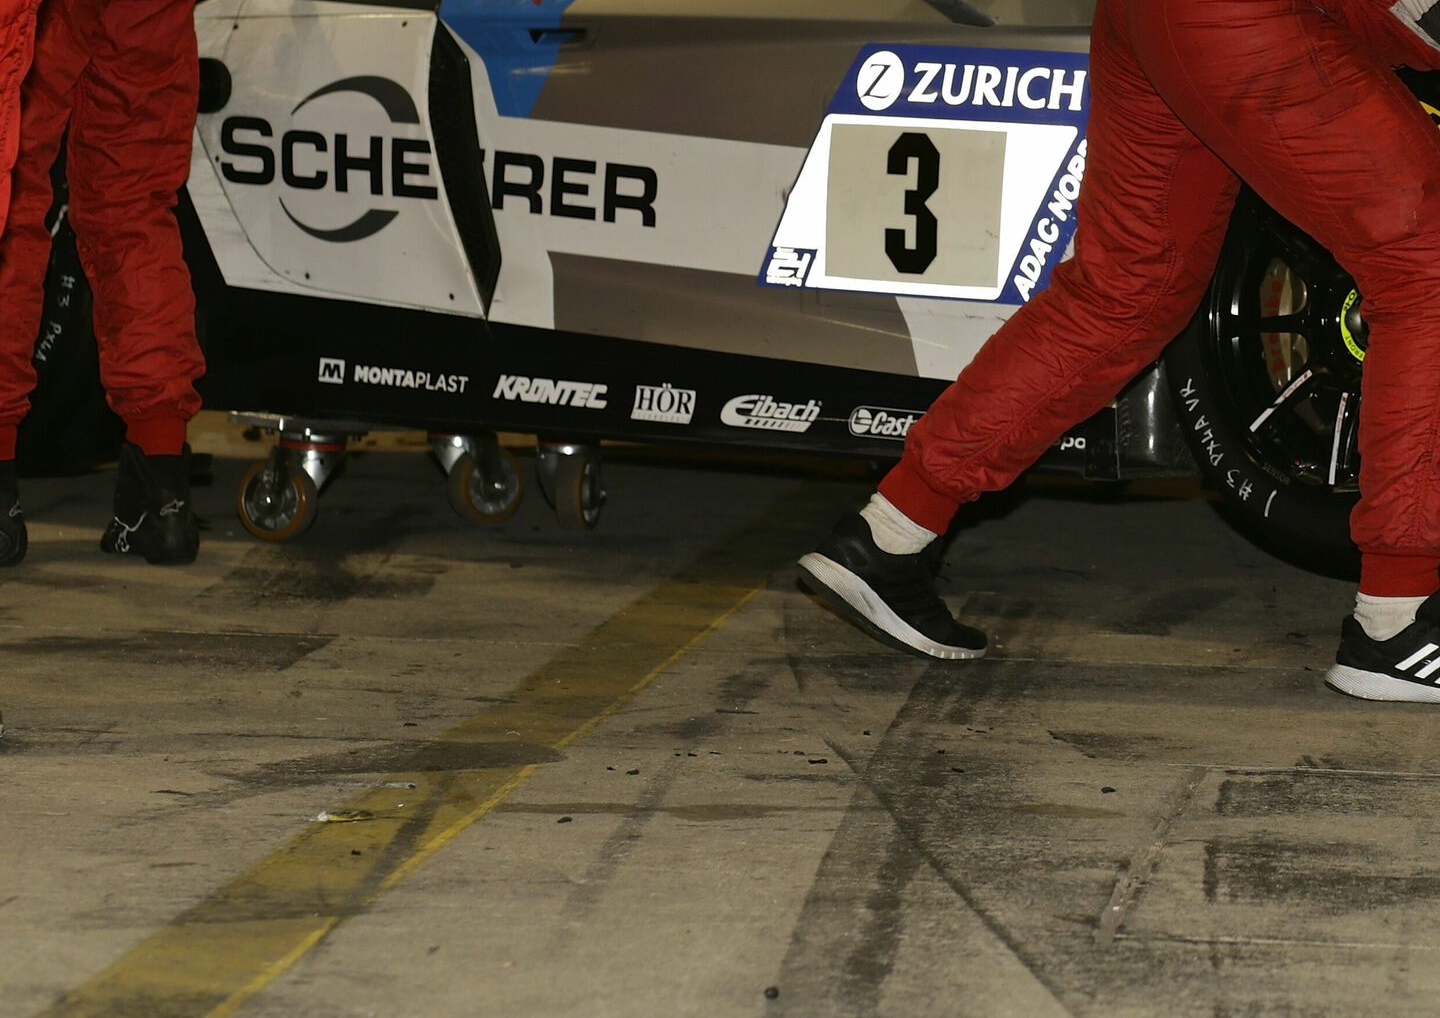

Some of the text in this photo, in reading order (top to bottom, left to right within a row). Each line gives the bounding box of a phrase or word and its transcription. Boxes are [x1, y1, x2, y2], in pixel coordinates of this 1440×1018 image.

[907, 61, 1088, 112] ZURICH
[220, 116, 659, 228] SCHERER
[884, 132, 941, 275] 3
[1012, 218, 1060, 303] ADAC
[353, 363, 470, 395] MONTAPLAST
[493, 373, 609, 410] KRONTEC
[1179, 377, 1200, 412] VR
[636, 382, 693, 415] HÖR
[721, 393, 821, 428] Eibach
